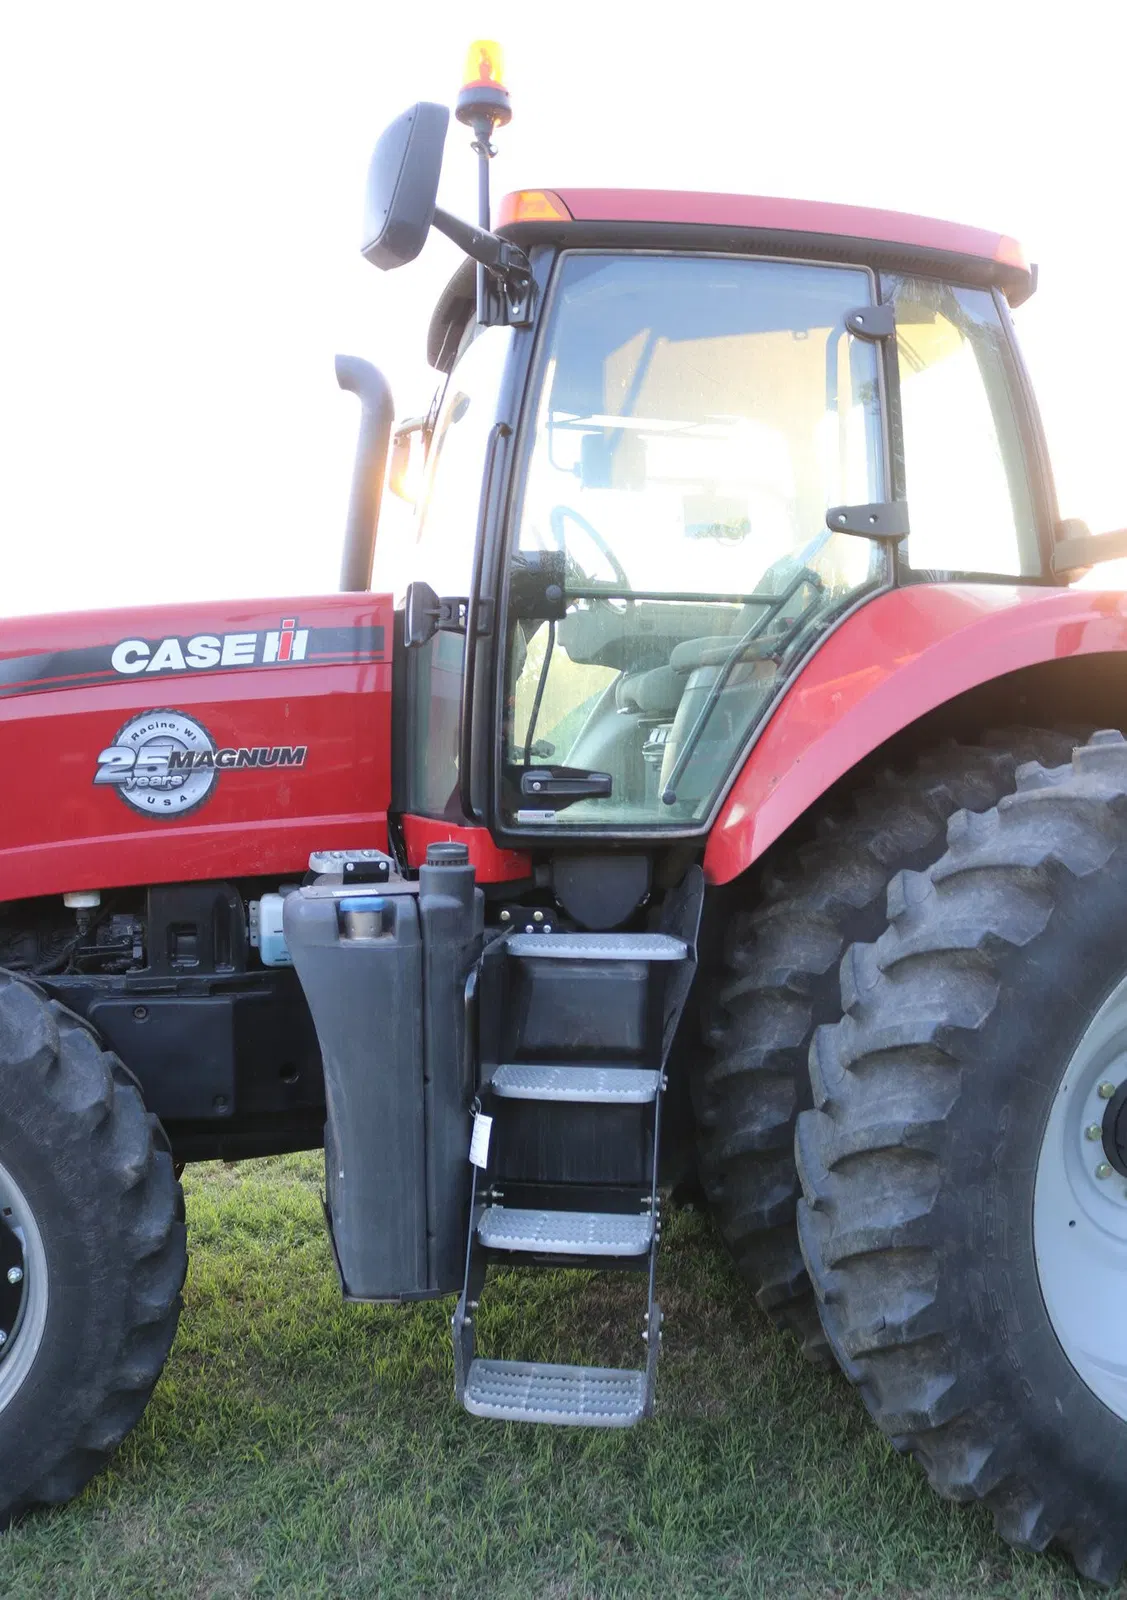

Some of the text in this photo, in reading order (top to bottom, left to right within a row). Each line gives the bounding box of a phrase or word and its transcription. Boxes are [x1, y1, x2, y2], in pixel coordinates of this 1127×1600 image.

[111, 633, 258, 674] CASE
[130, 720, 198, 742] Racine, WI
[93, 745, 174, 784] 25
[167, 746, 307, 769] MAGNUM
[125, 774, 183, 791] years
